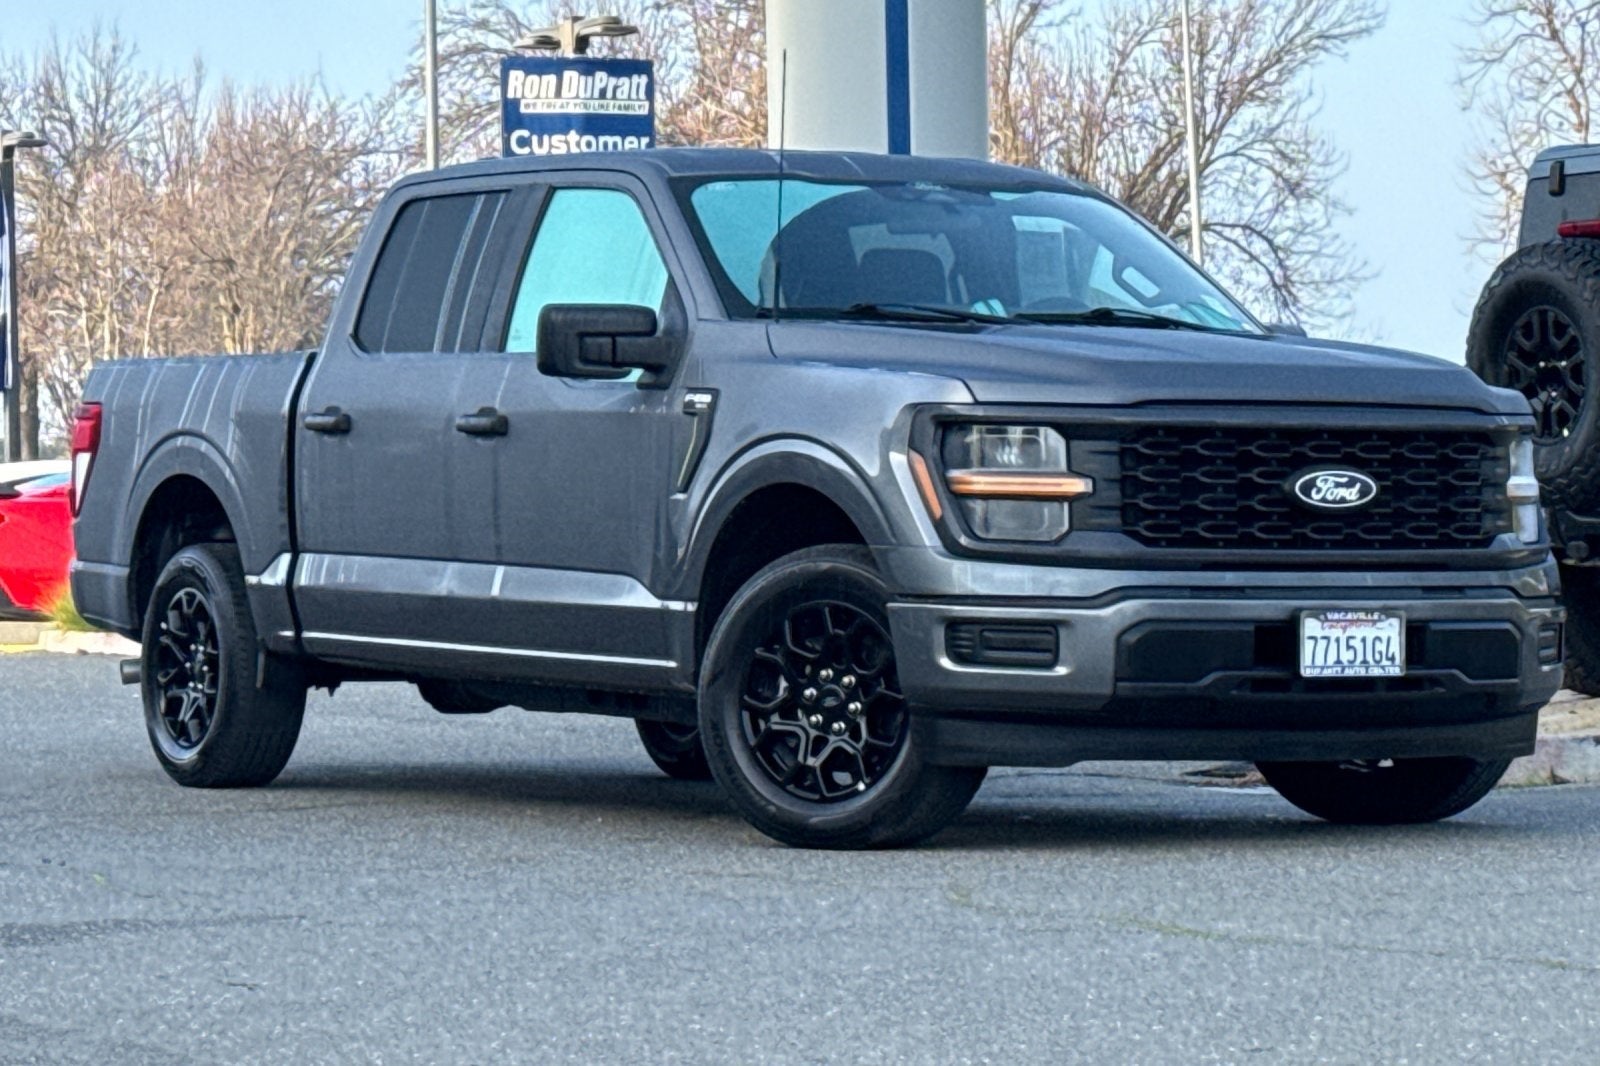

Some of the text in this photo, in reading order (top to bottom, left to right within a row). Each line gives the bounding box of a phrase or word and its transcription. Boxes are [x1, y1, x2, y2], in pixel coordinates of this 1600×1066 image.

[507, 70, 649, 100] Ron DuPratt
[523, 102, 538, 110] WE
[573, 102, 591, 111] YOU
[592, 102, 611, 111] LIKE
[509, 129, 650, 155] Customer
[1311, 475, 1361, 501] Ford
[1306, 635, 1396, 665] 77151G4
